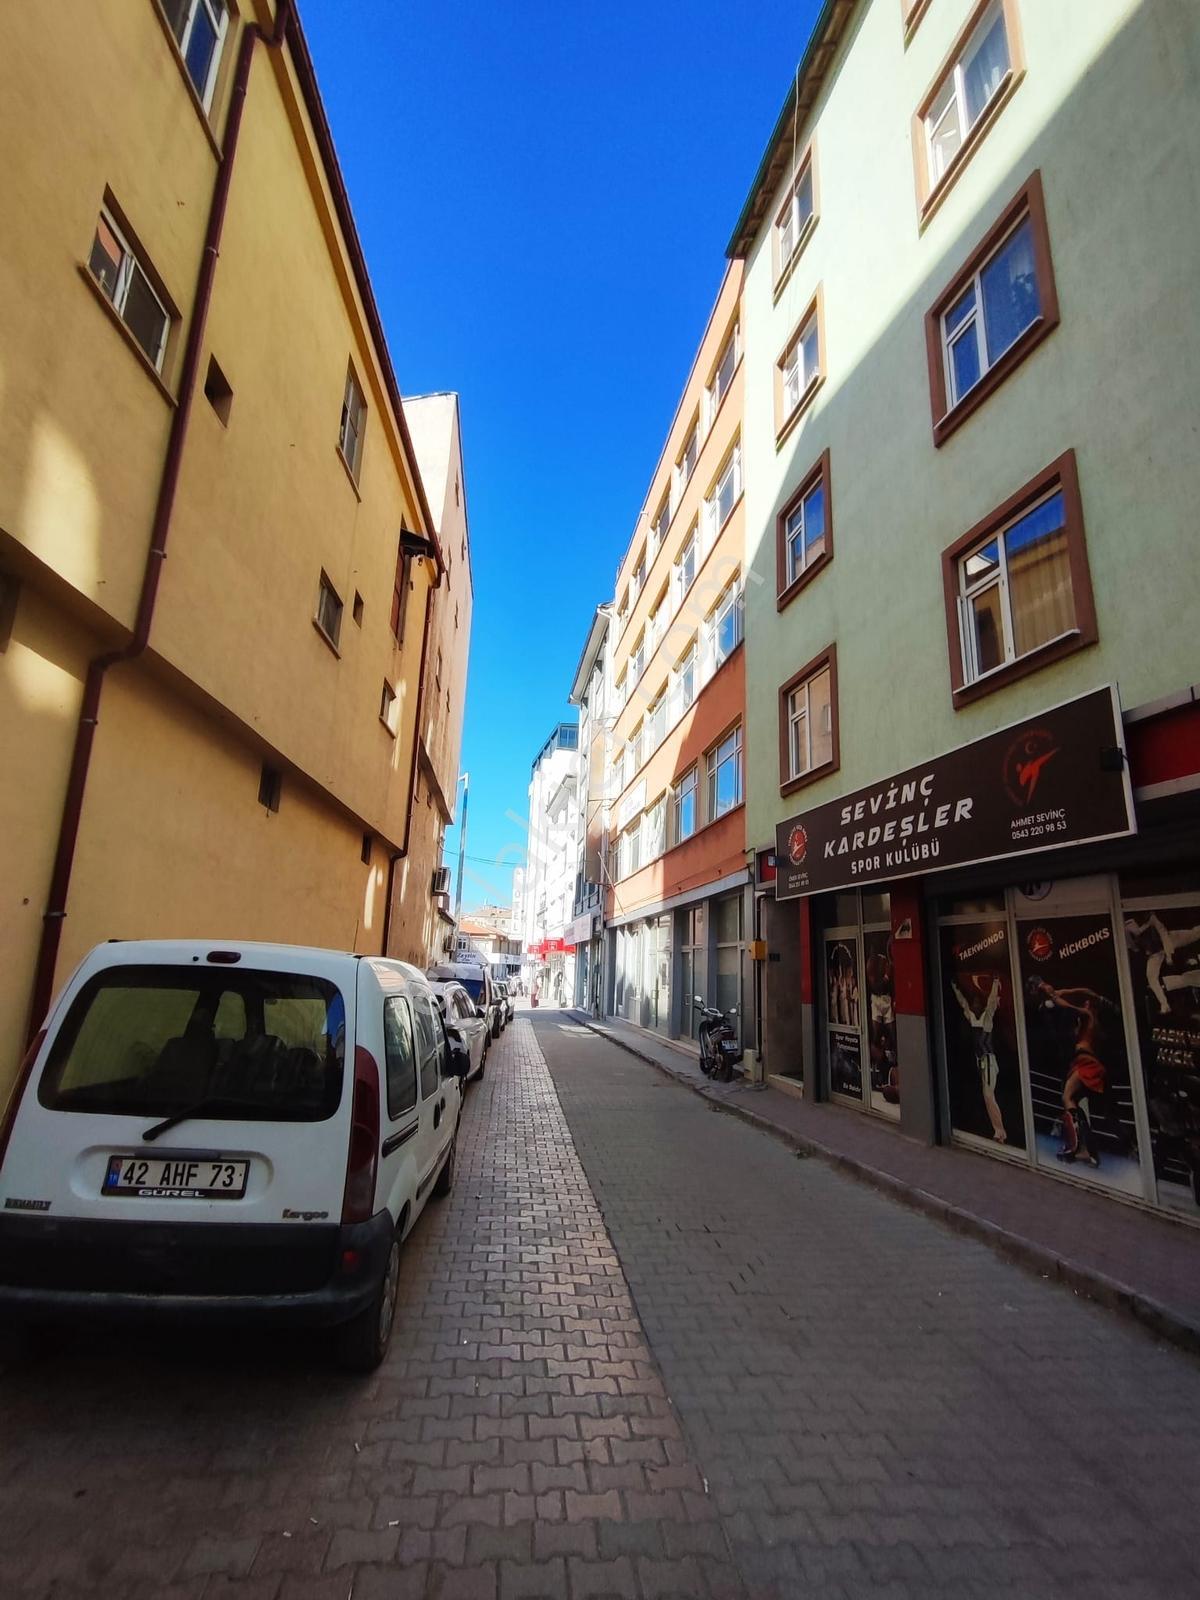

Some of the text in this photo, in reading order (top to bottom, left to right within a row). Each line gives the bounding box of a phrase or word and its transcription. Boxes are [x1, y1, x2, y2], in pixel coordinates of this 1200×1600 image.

[840, 774, 935, 827] SEVİNÇ
[823, 798, 974, 858] KARDEŞLER
[1011, 809, 1066, 828] AHMET SEVİNÇ
[1012, 820, 1067, 840] 0543 220 98 53
[851, 838, 940, 875] SPOR KULÜBÜ
[958, 930, 1005, 961] TAEKWONDO
[1059, 928, 1110, 959] KİCKBOKS
[122, 1162, 148, 1186] 42
[160, 1163, 199, 1186] AHF
[209, 1164, 235, 1187] 73
[138, 1188, 205, 1198] GÜREL
